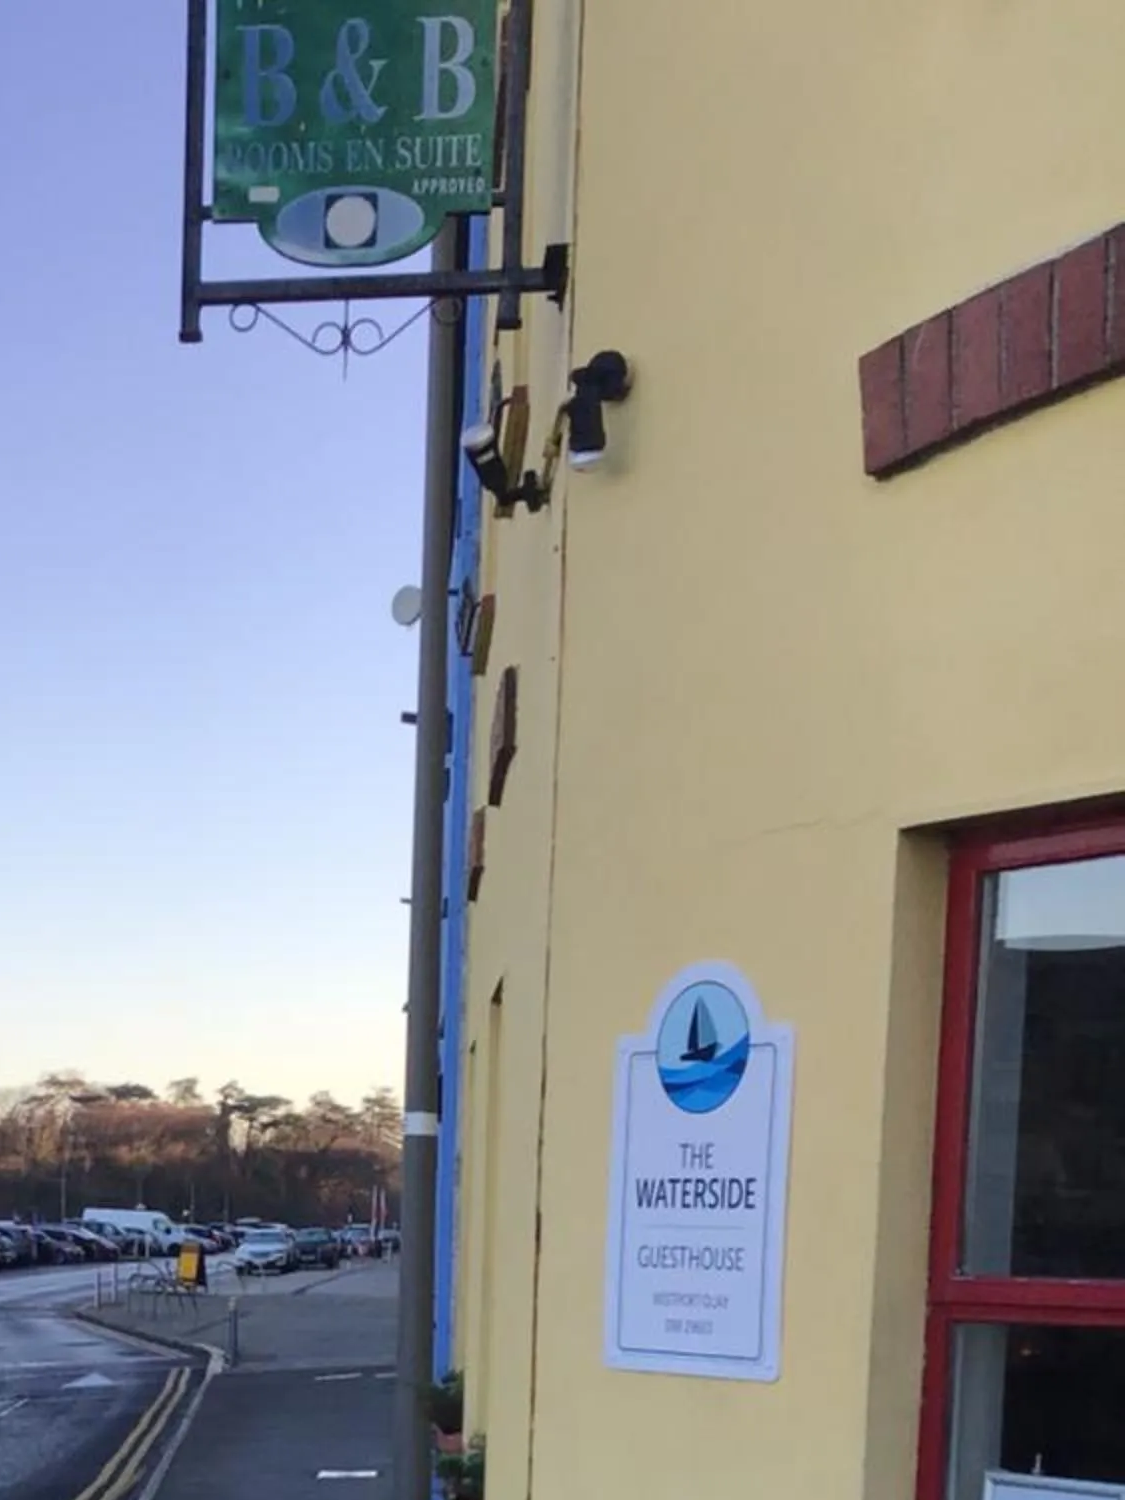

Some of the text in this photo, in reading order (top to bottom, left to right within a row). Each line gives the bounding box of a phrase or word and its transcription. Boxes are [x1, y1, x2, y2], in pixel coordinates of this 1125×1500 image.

[235, 15, 476, 129] B & B
[346, 137, 385, 173] EN
[395, 133, 483, 170] SUITE
[411, 176, 486, 195] APPROVED
[679, 1141, 715, 1170] THE
[636, 1177, 758, 1210] WATERSIDE
[637, 1244, 745, 1272] GUESTHOUSE
